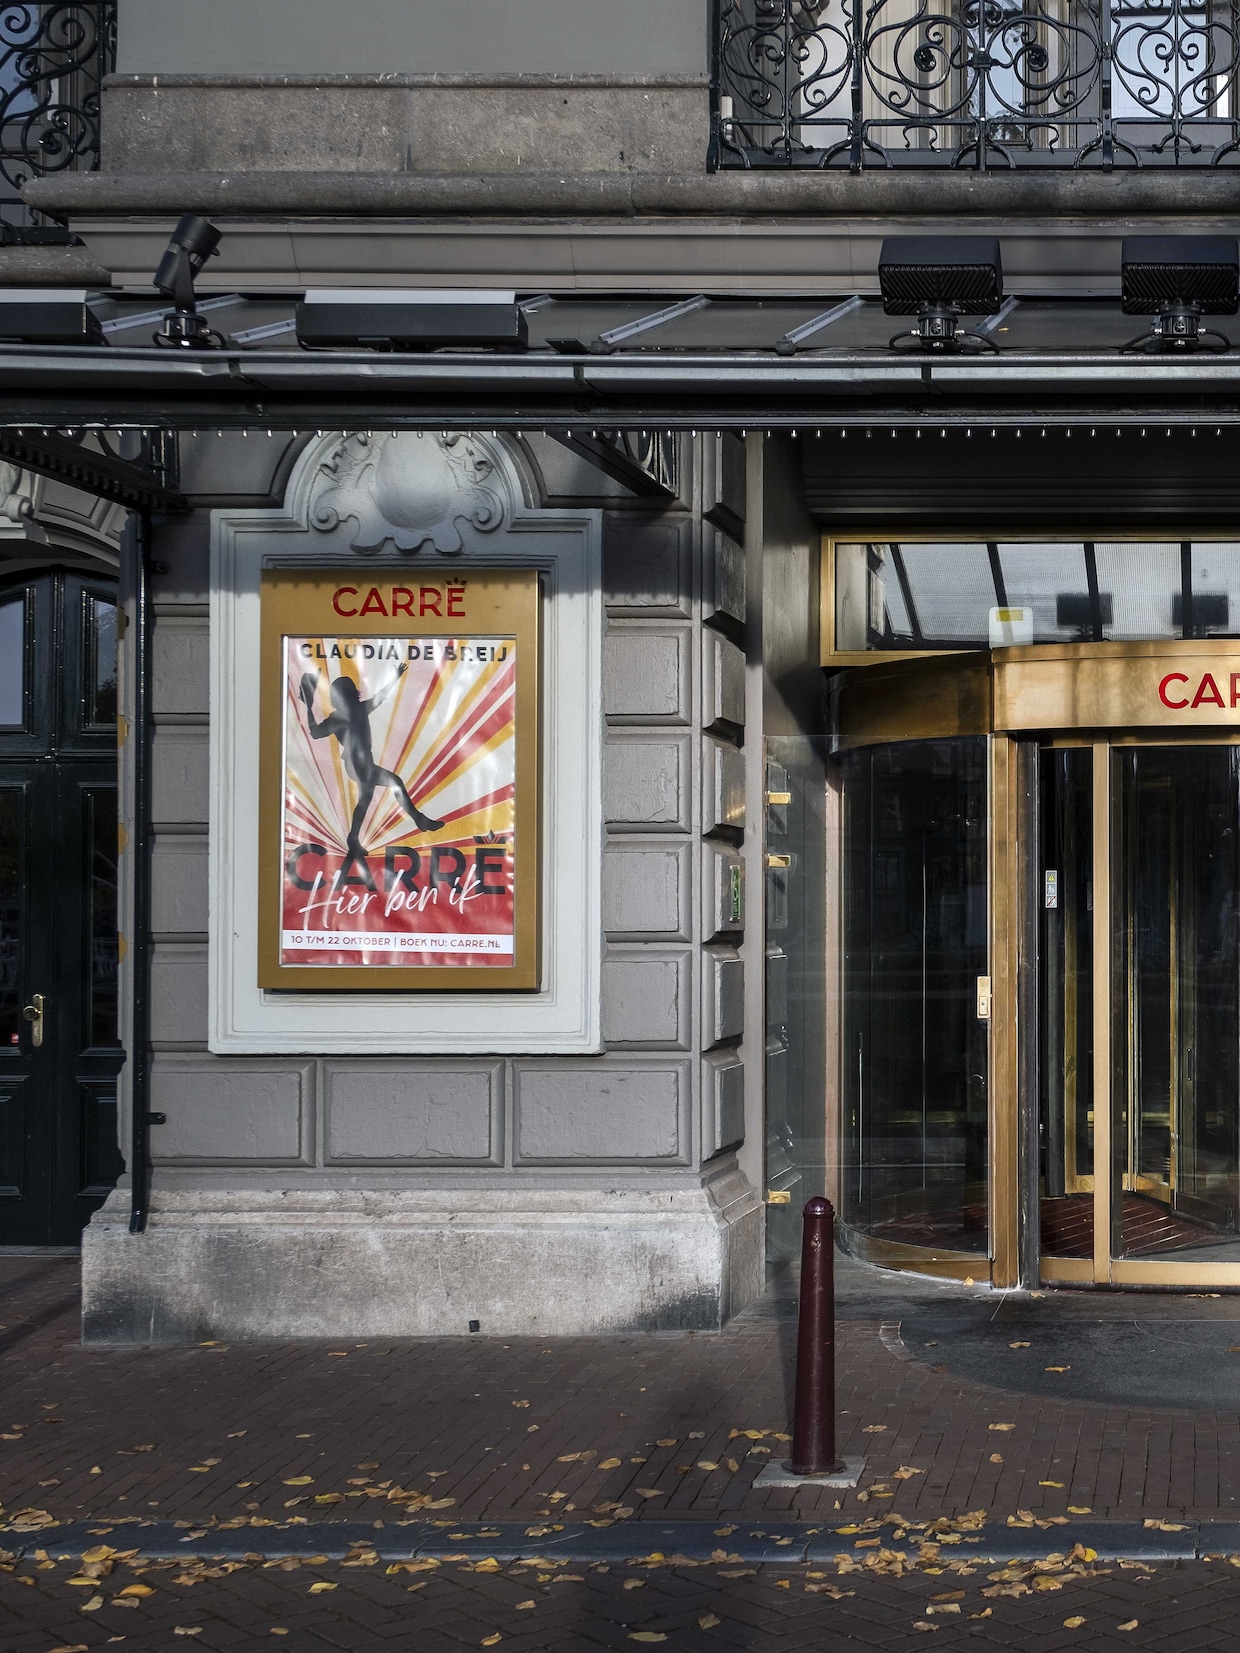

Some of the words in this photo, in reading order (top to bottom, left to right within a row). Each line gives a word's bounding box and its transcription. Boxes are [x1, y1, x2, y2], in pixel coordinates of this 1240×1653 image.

[300, 643, 399, 660] CLAUDIA
[407, 645, 434, 661] DE
[445, 646, 507, 662] BREIJ
[299, 869, 378, 931] Hier
[384, 869, 437, 917] ben
[449, 864, 485, 914] ik
[291, 935, 303, 944] 10
[305, 936, 325, 945] T/M
[327, 936, 340, 945] 22
[342, 937, 391, 946] OKTOBER
[400, 938, 428, 947] BOEK
[431, 939, 447, 947] NU:
[450, 939, 501, 948] CARRE.NL
